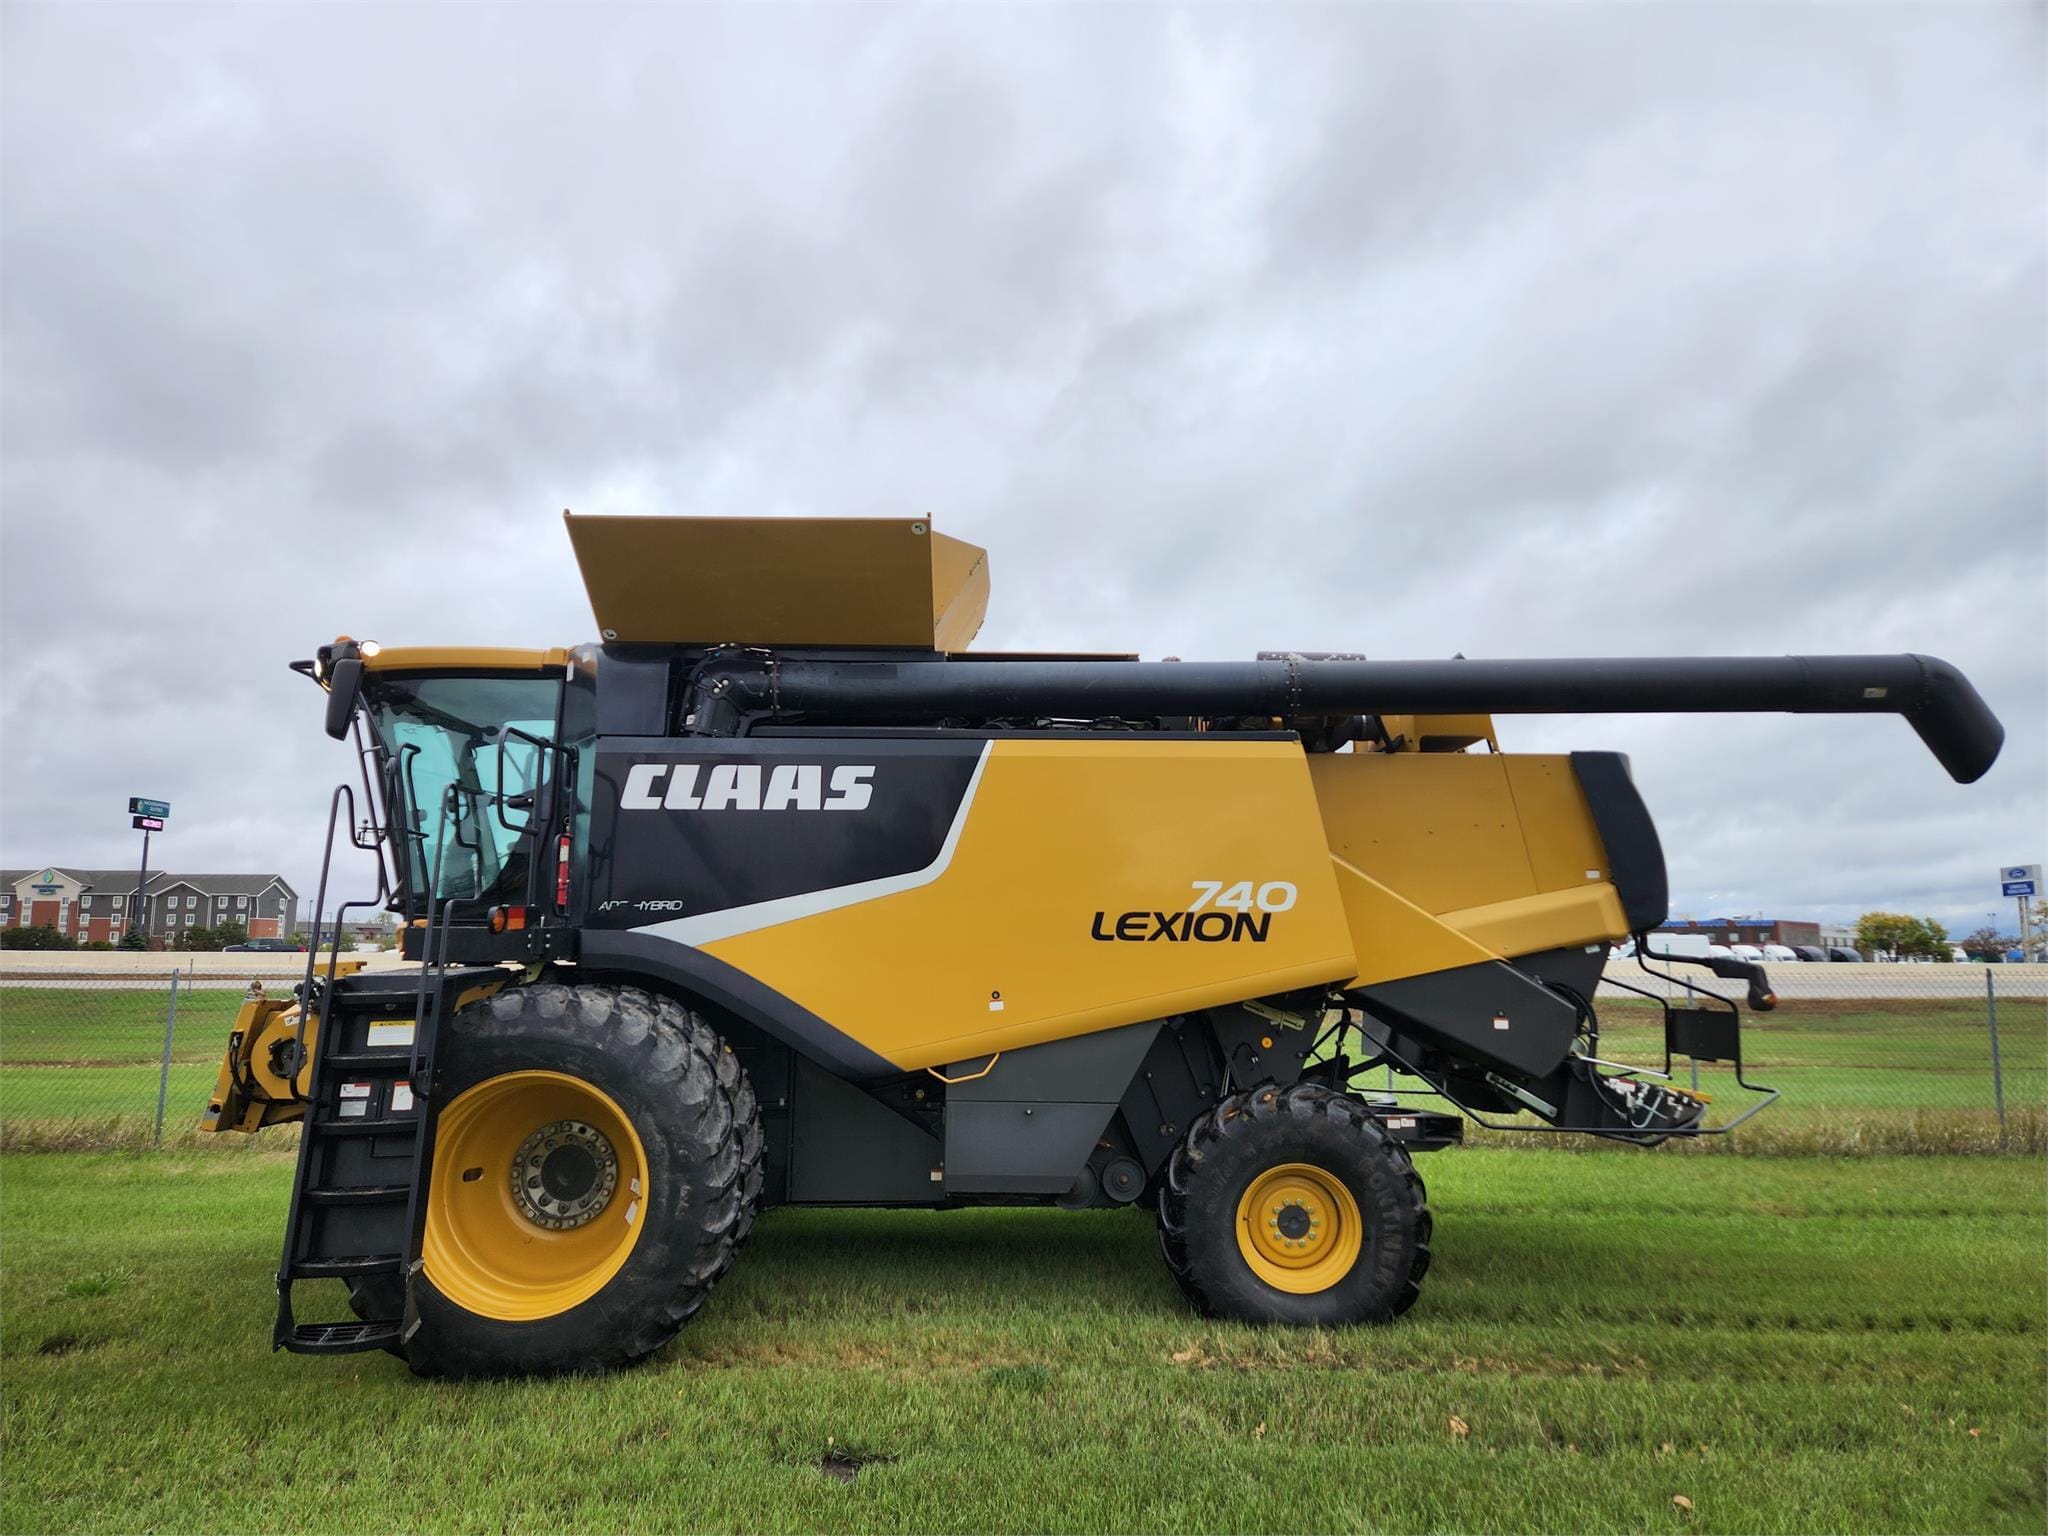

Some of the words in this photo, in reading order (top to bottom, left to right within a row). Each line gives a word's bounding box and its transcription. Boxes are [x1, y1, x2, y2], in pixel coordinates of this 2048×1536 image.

[620, 764, 876, 810] CLAAS
[1187, 881, 1298, 913] 740
[1091, 911, 1272, 942] LEXION
